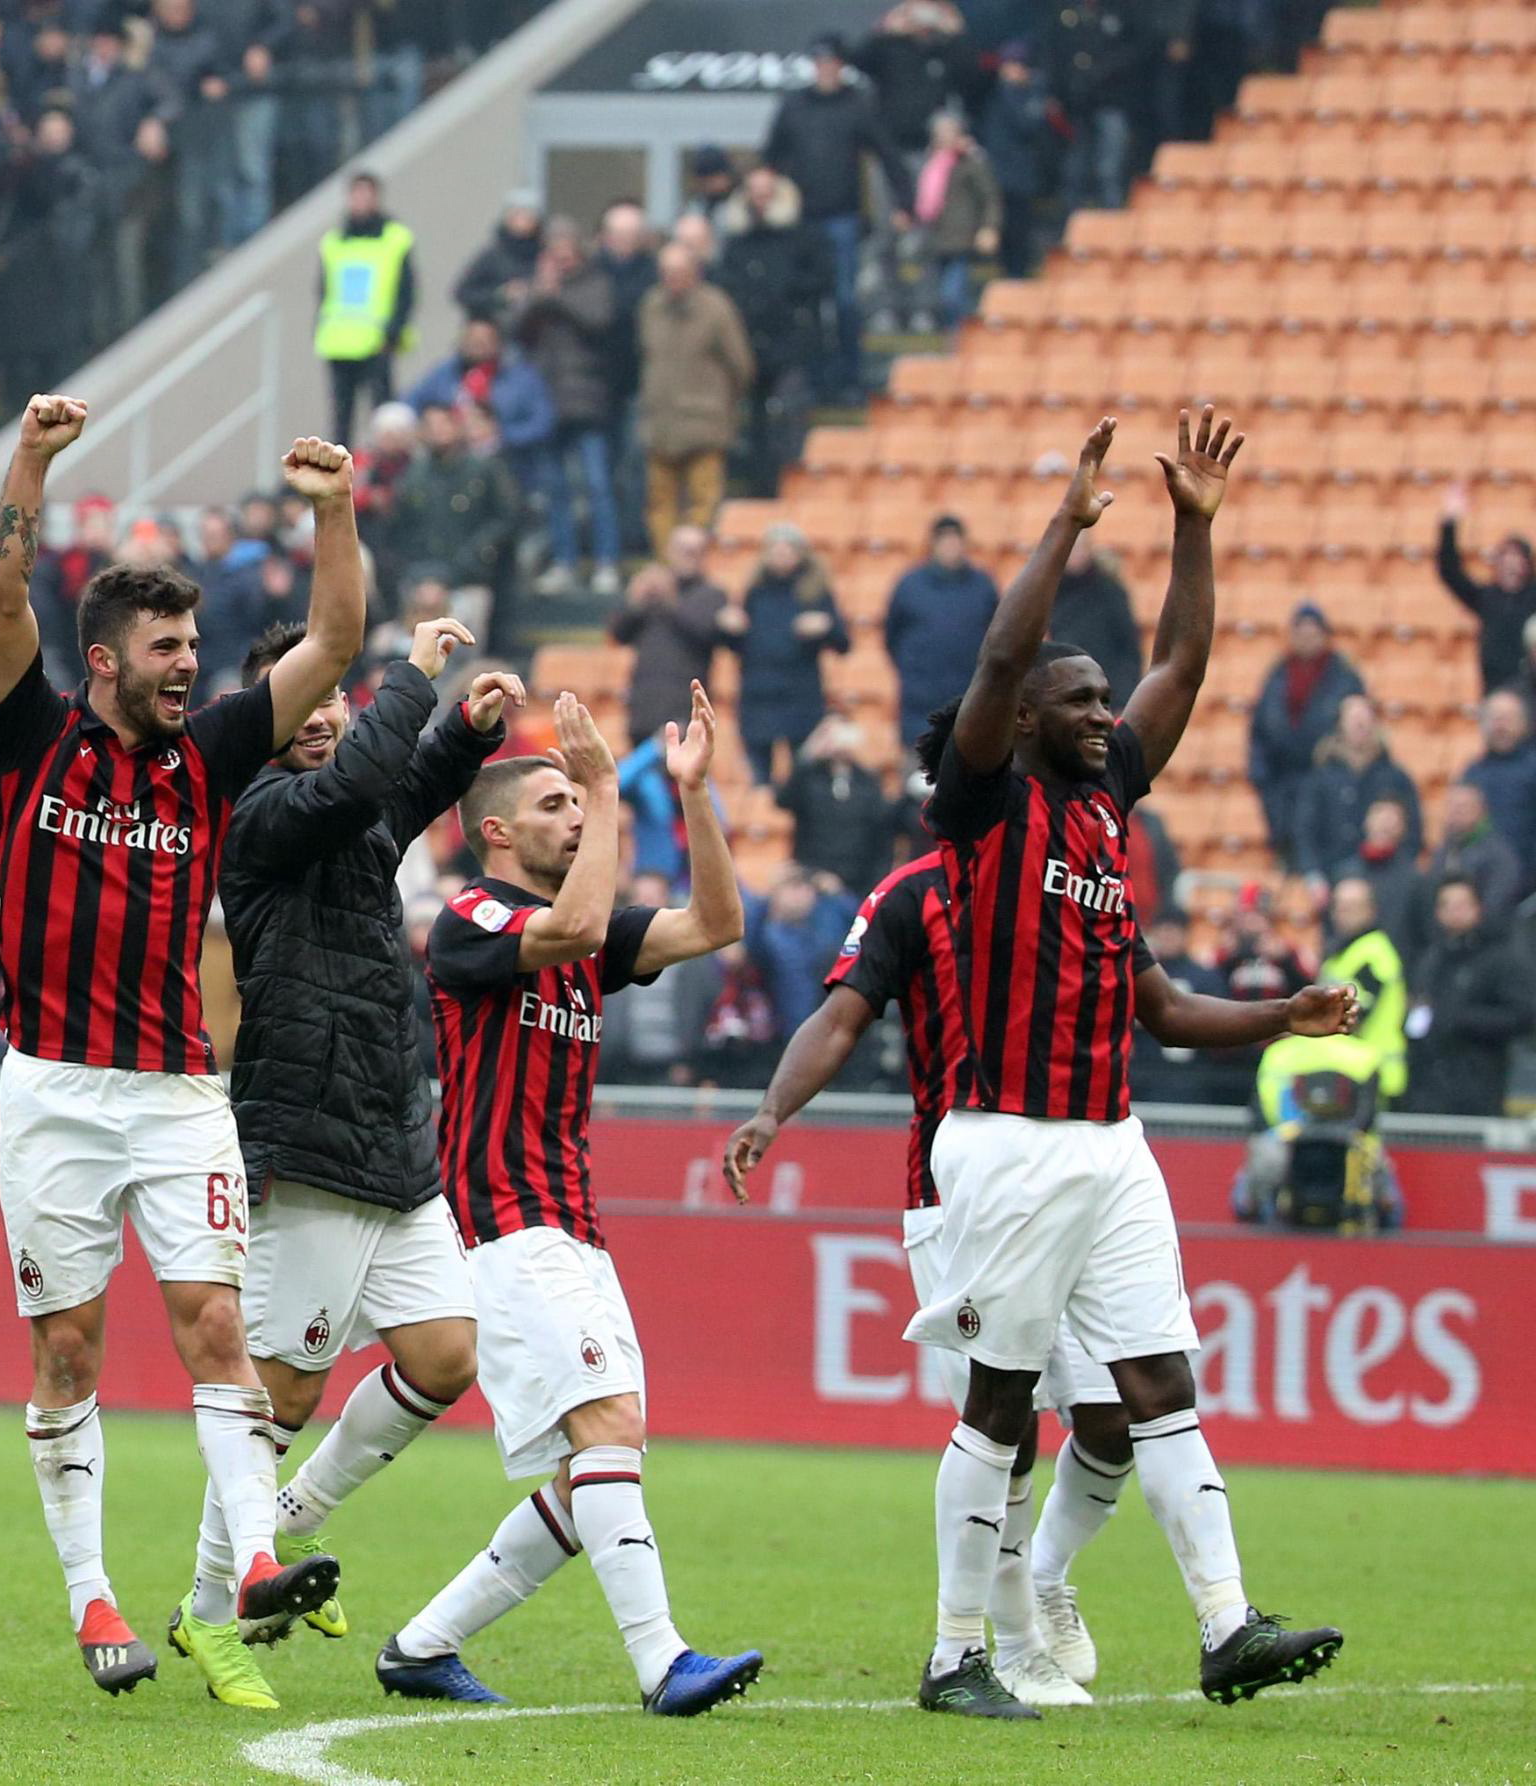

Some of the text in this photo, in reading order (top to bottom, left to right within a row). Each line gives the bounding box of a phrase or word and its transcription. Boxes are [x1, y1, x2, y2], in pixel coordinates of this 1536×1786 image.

[38, 794, 191, 855] Emirates
[207, 1166, 247, 1234] 63
[810, 1232, 1482, 1428] Eates
